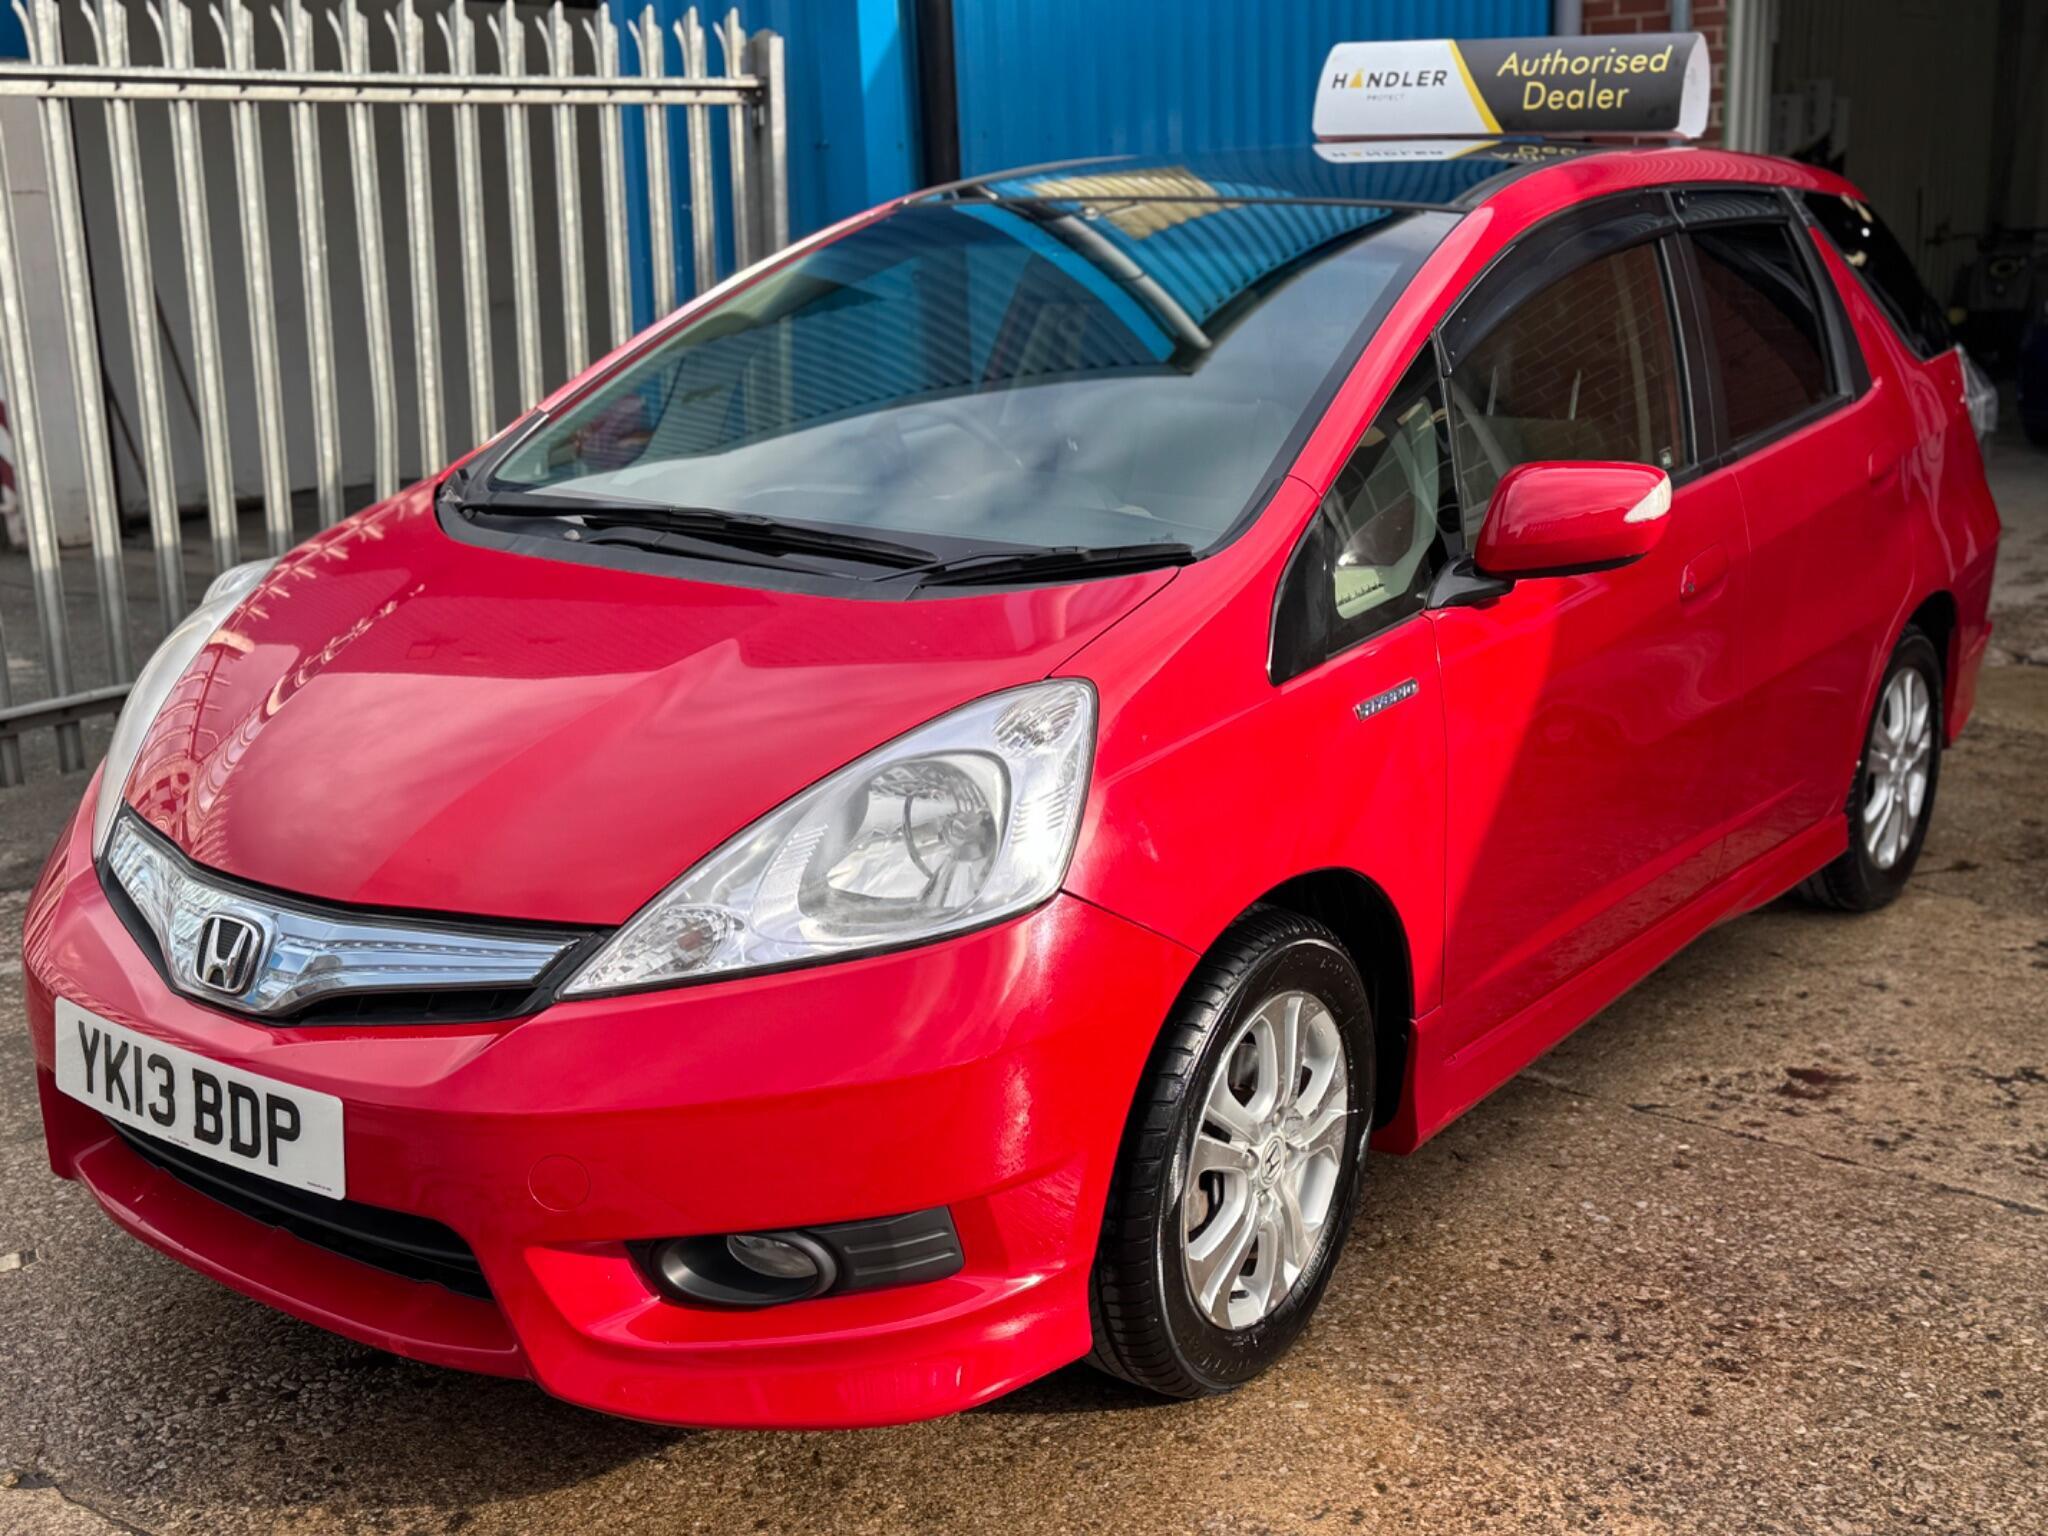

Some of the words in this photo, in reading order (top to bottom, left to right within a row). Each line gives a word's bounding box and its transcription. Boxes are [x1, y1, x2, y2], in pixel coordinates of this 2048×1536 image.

[1496, 45, 1673, 77] Authorised
[1332, 69, 1447, 88] HANDLER
[1522, 79, 1628, 111] Dealer
[78, 1020, 176, 1127] YK13
[192, 1068, 301, 1167] BDP
